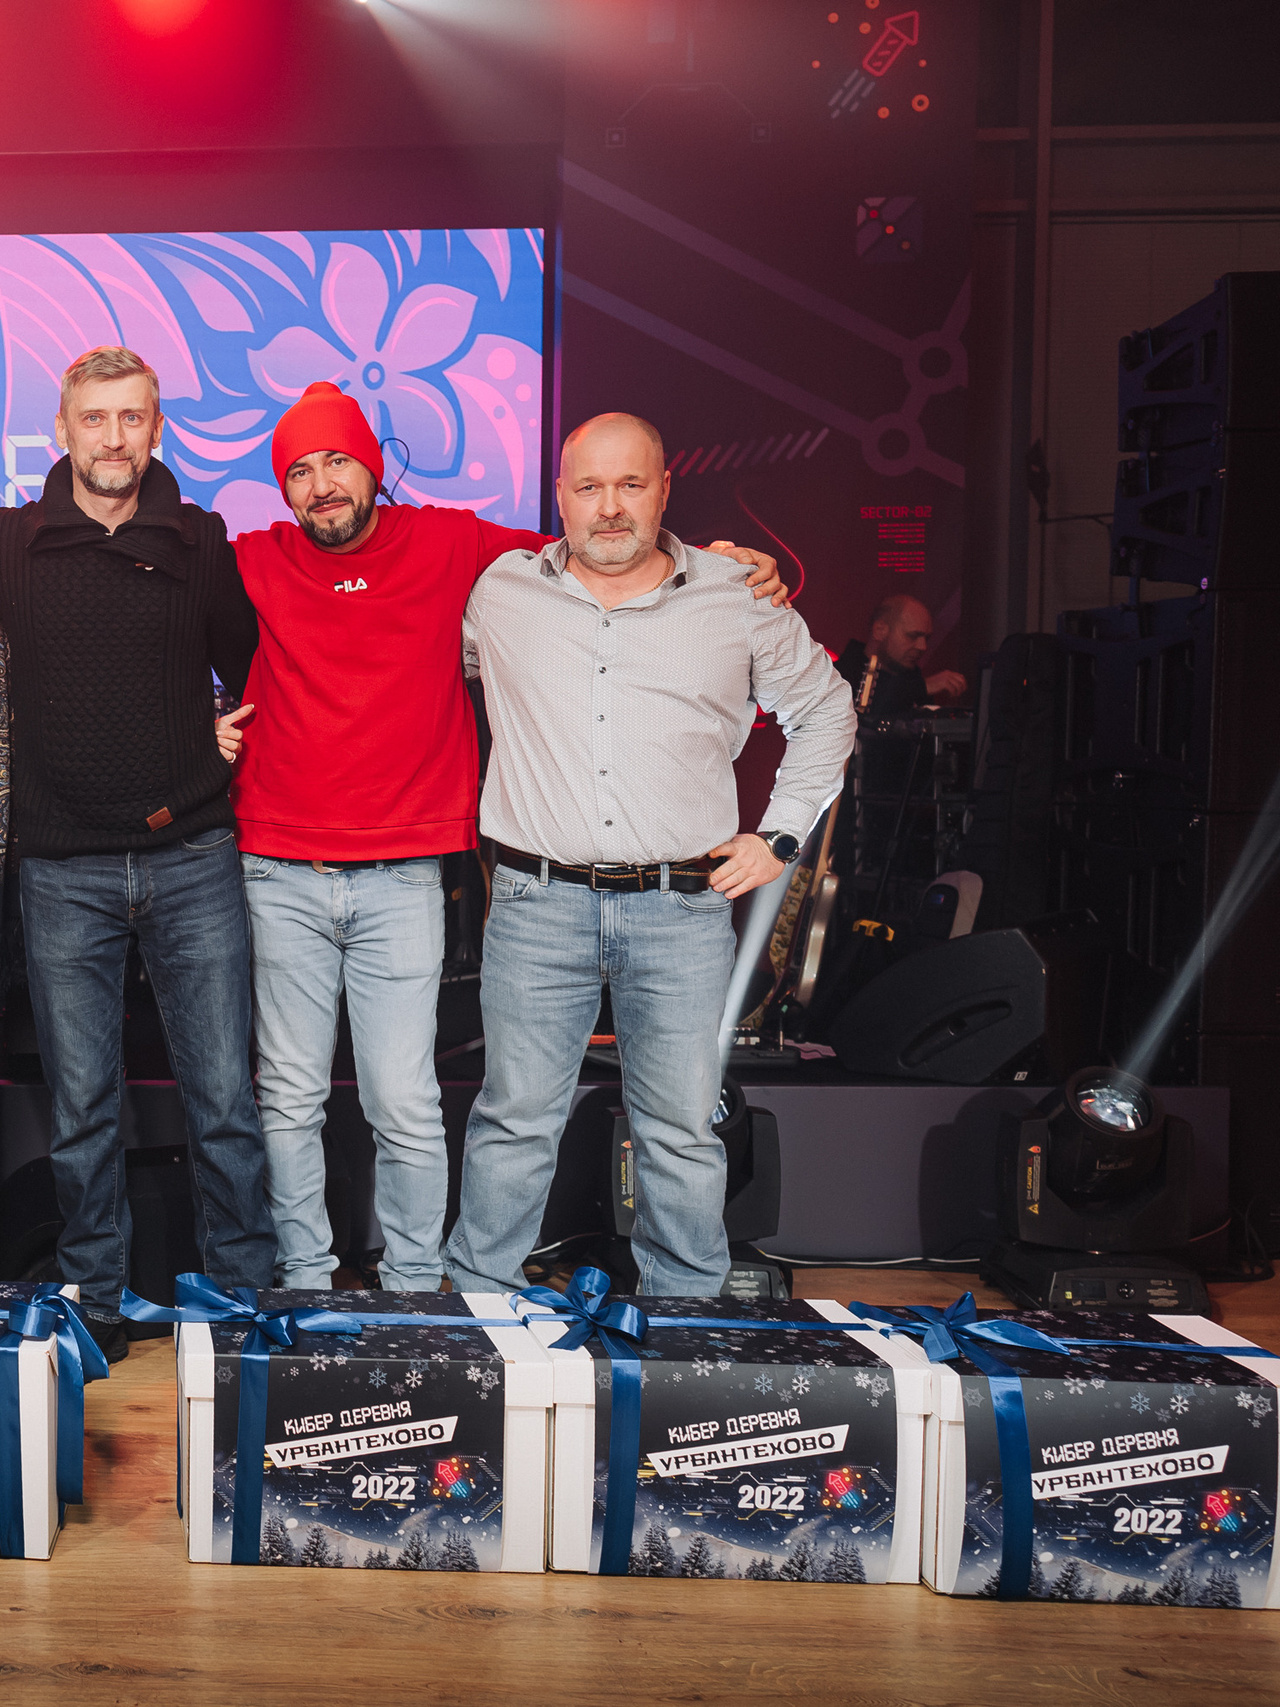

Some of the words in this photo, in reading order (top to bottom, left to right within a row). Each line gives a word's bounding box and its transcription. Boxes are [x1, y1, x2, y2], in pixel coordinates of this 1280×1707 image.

[334, 577, 368, 593] FILA
[283, 1413, 334, 1436] КИБЕР
[340, 1400, 412, 1428] ДЕРЕВНЯ
[668, 1421, 720, 1444] КИБЕР
[726, 1407, 801, 1436] ДЕРЕВНЯ
[275, 1423, 445, 1462] УРБАНТЕХОВО
[659, 1432, 835, 1471] УРБАНТЕХОВО
[1041, 1441, 1095, 1465] КИБЕР
[1102, 1428, 1180, 1457] ДЕРЕВНЯ
[351, 1474, 416, 1500] 2022
[1033, 1453, 1215, 1493] УРБАНТЕХОВО
[737, 1484, 805, 1511] 2022
[1113, 1507, 1182, 1534] 2022
